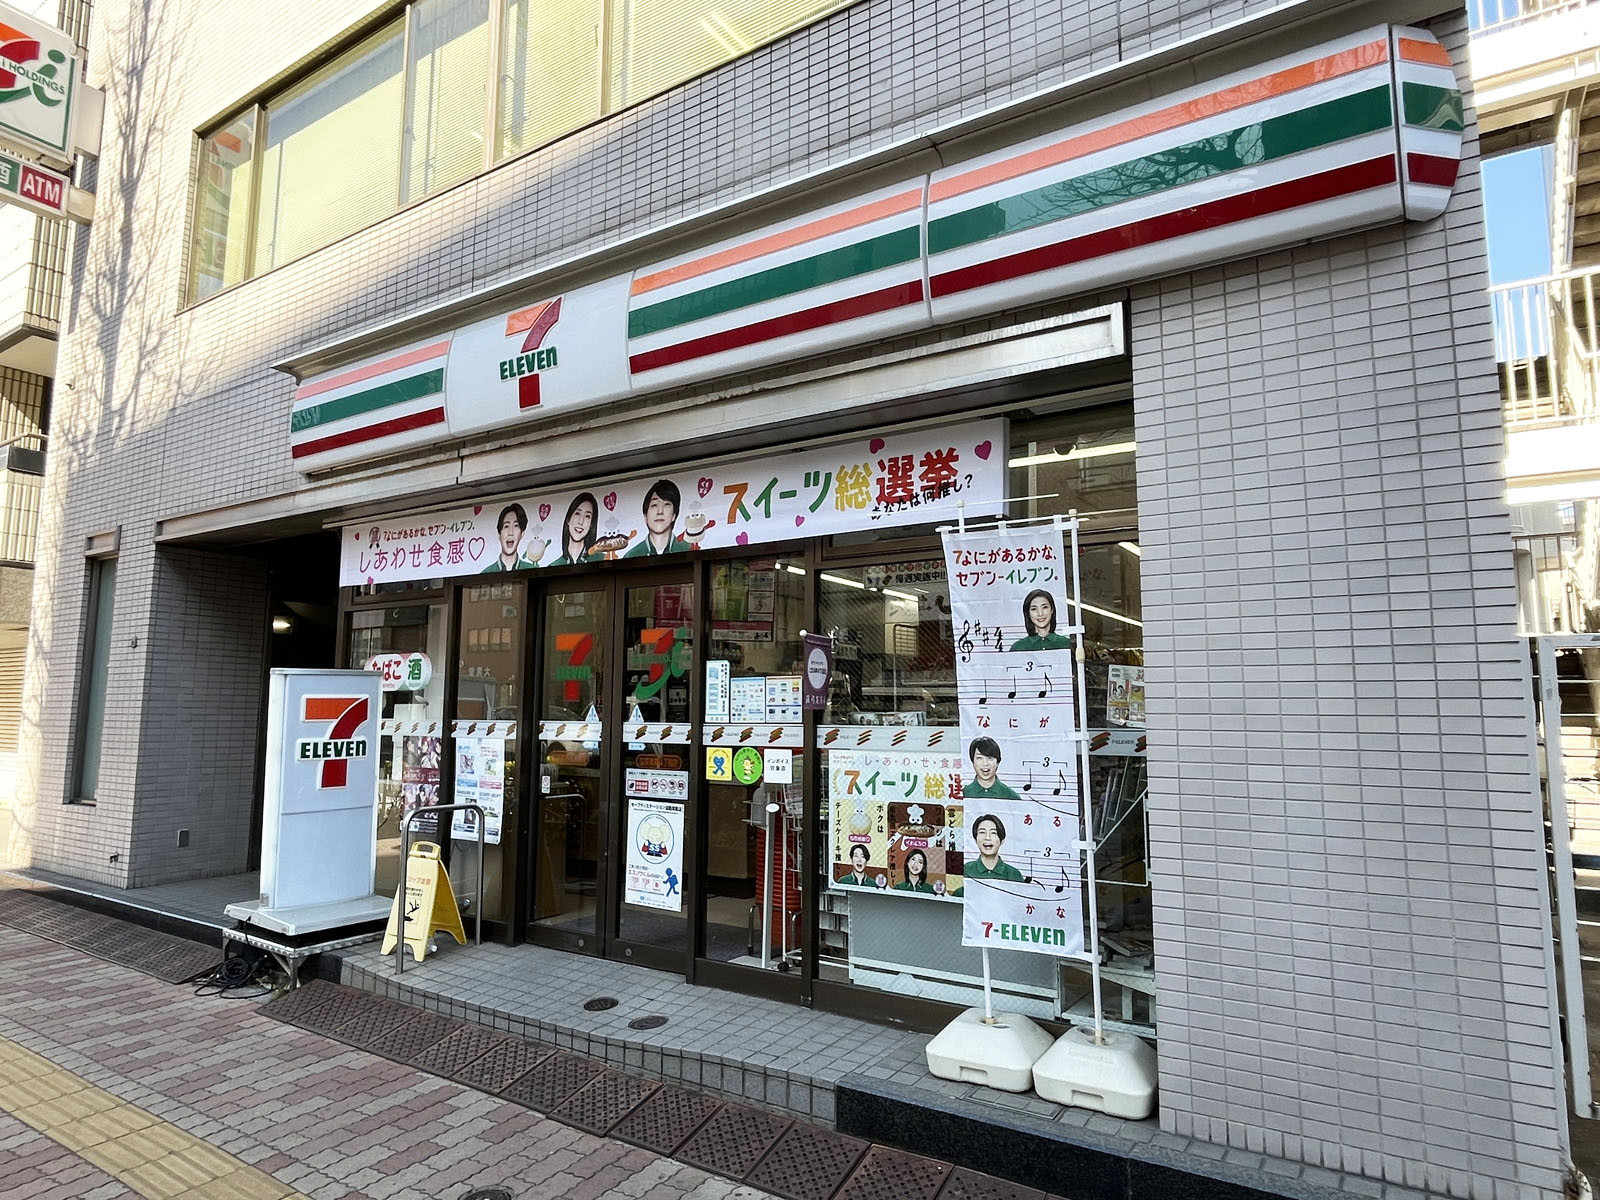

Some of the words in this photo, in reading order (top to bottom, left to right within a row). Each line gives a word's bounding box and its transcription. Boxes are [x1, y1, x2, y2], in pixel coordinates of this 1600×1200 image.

[8, 62, 65, 95] HOLDINGS
[23, 172, 60, 204] ATM
[723, 448, 960, 524] スイーツ総選挙
[408, 658, 422, 680] 酒
[305, 697, 368, 788] 7
[876, 803, 884, 833] ボクは
